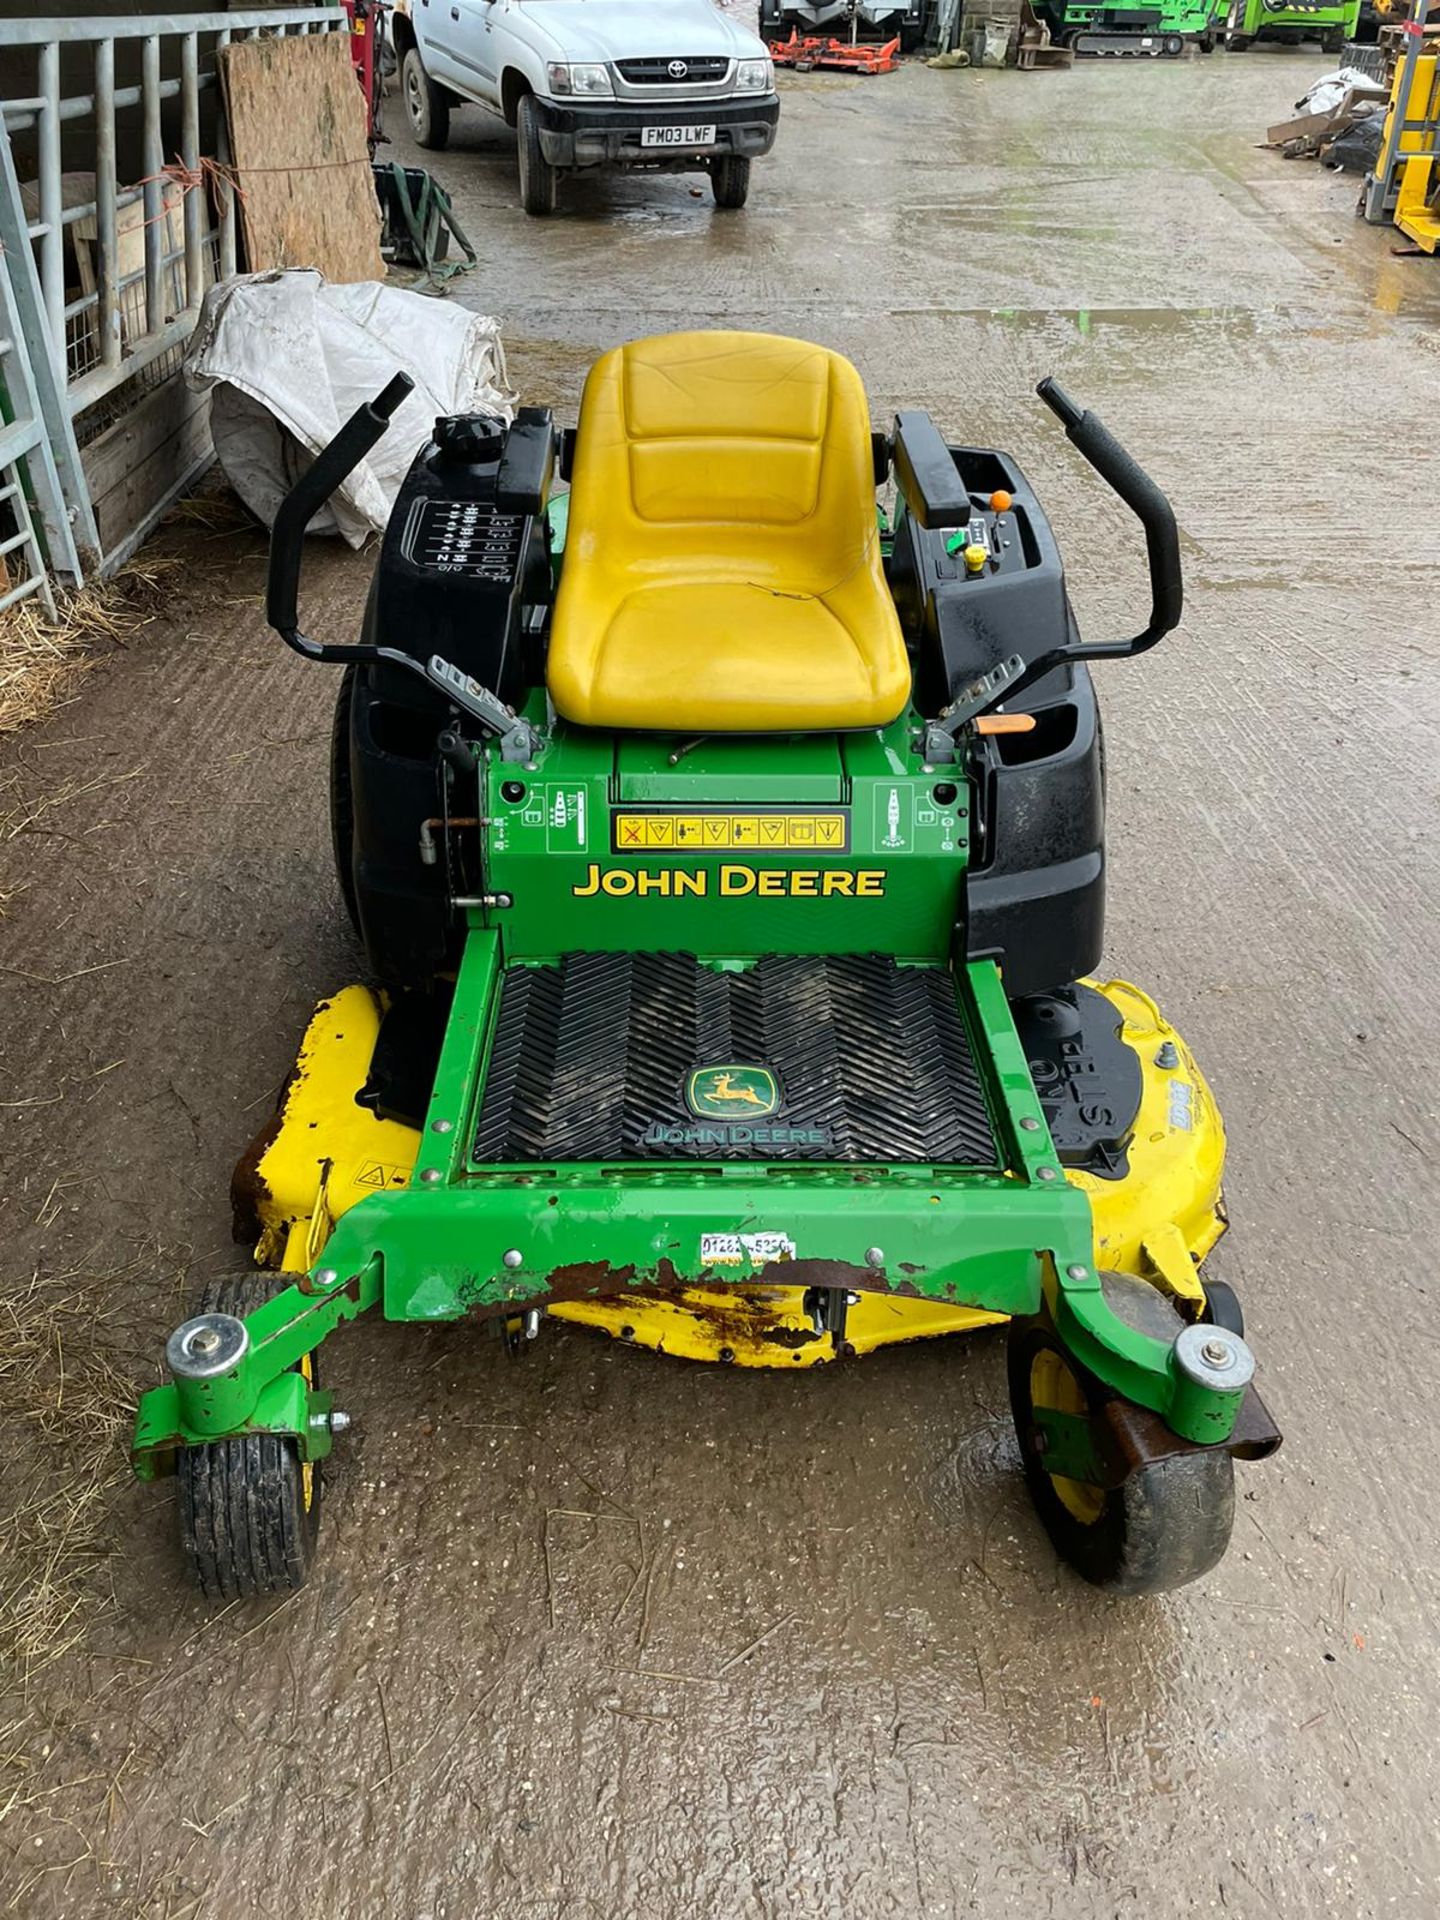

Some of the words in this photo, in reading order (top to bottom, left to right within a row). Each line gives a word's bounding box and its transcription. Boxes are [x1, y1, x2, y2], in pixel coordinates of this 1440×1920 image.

[647, 128, 682, 143] FM03
[685, 127, 711, 142] LWF
[572, 863, 708, 897] JOHN
[718, 863, 886, 897] DEERE
[645, 1126, 725, 1145] JOHN
[729, 1126, 829, 1144] DEERE
